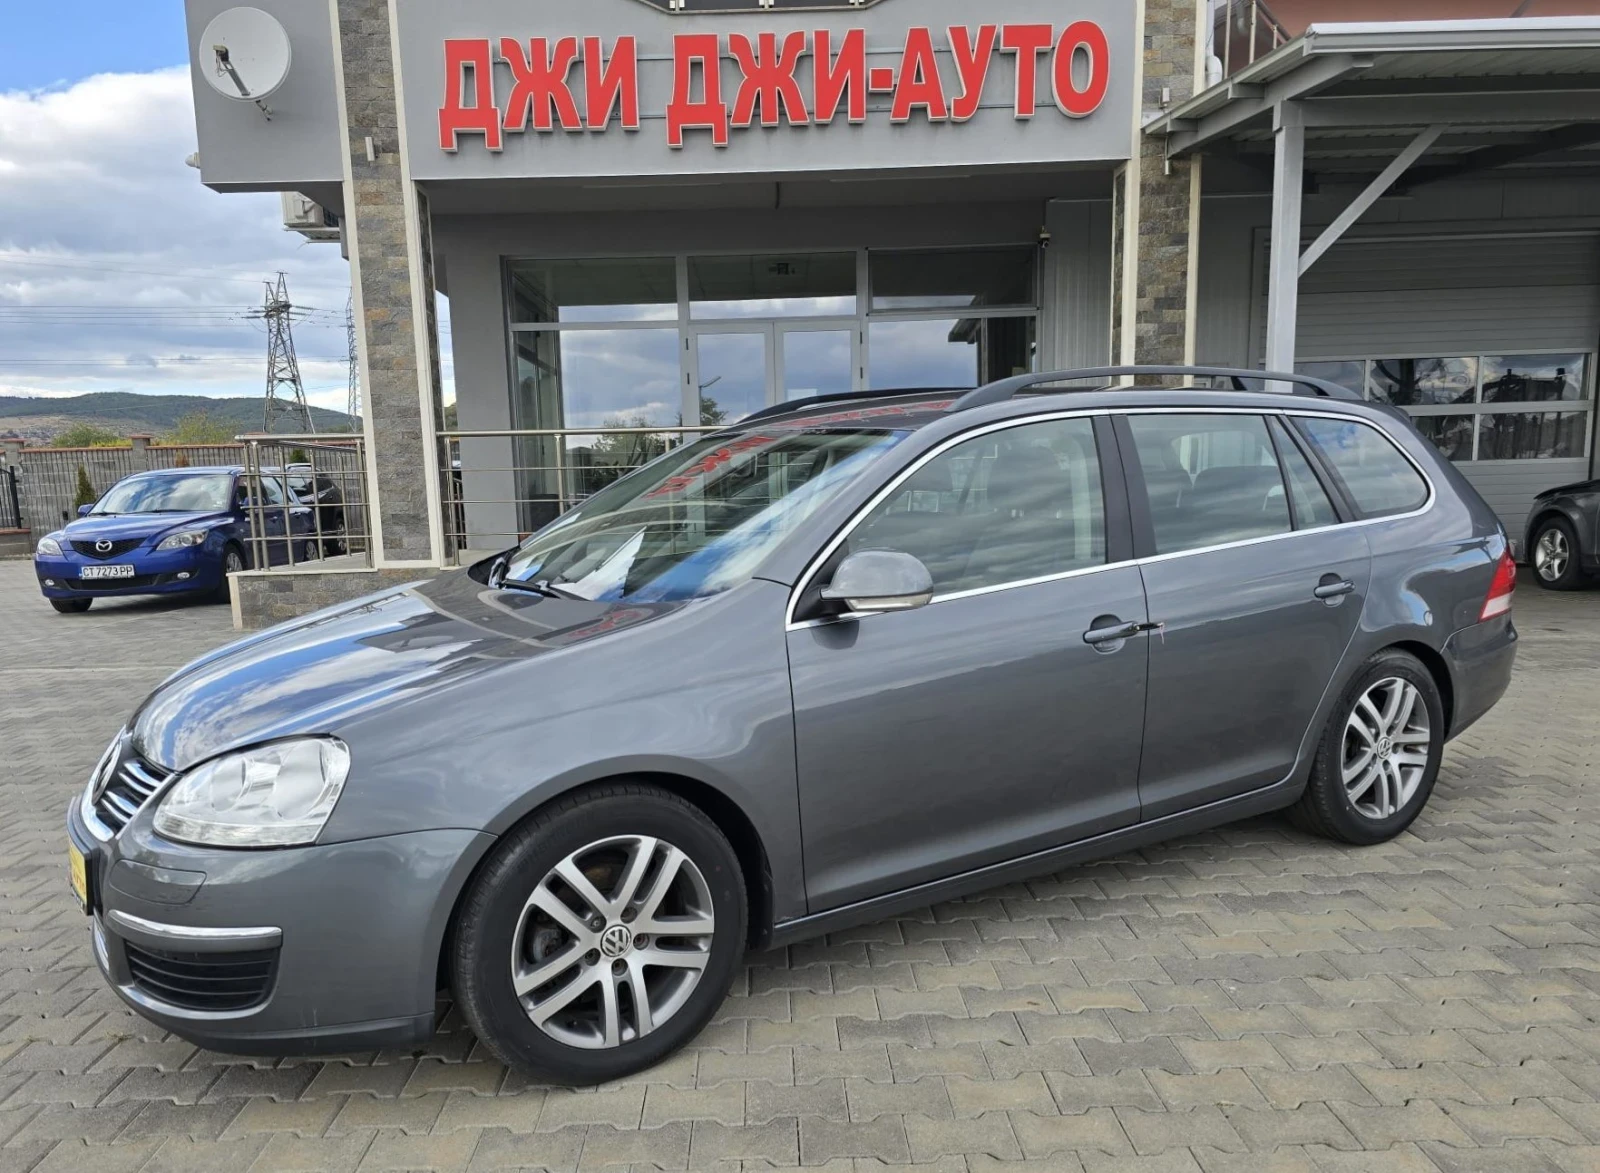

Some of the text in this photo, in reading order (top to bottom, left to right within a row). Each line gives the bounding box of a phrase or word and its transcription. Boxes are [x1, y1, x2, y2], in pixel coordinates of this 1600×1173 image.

[439, 20, 1110, 152] ДЖИ ДЖИ-АУТО
[96, 566, 119, 577] 7273
[602, 926, 630, 956] VW
